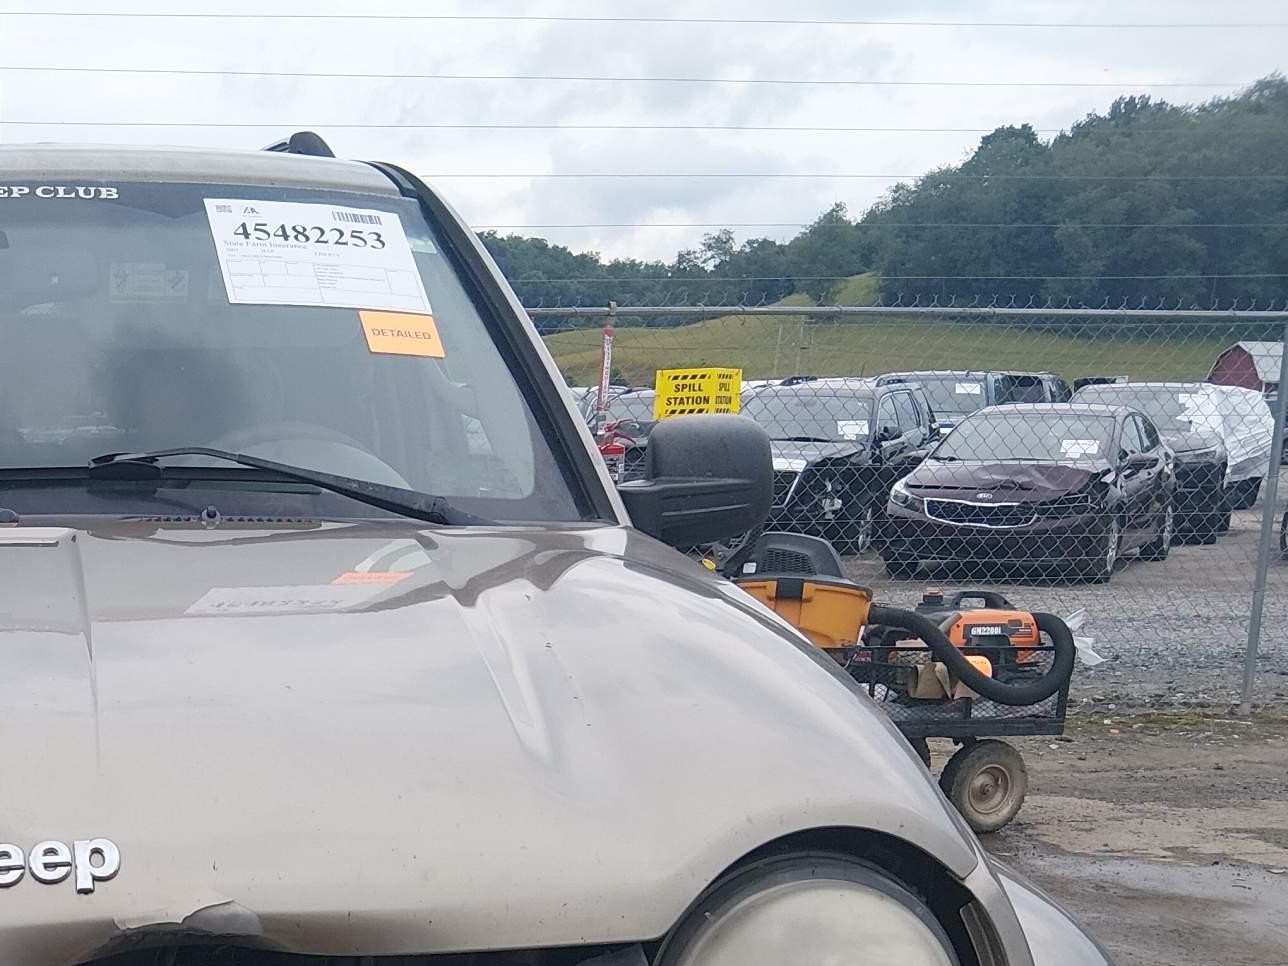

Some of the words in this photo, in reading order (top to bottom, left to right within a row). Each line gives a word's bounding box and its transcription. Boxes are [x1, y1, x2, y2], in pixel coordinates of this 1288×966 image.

[35, 186, 119, 199] CLUB
[233, 221, 386, 250] 45482253
[371, 327, 432, 341] DETAILED
[673, 382, 704, 393] SPILL
[718, 382, 730, 392] SPILL
[665, 395, 710, 406] STATION
